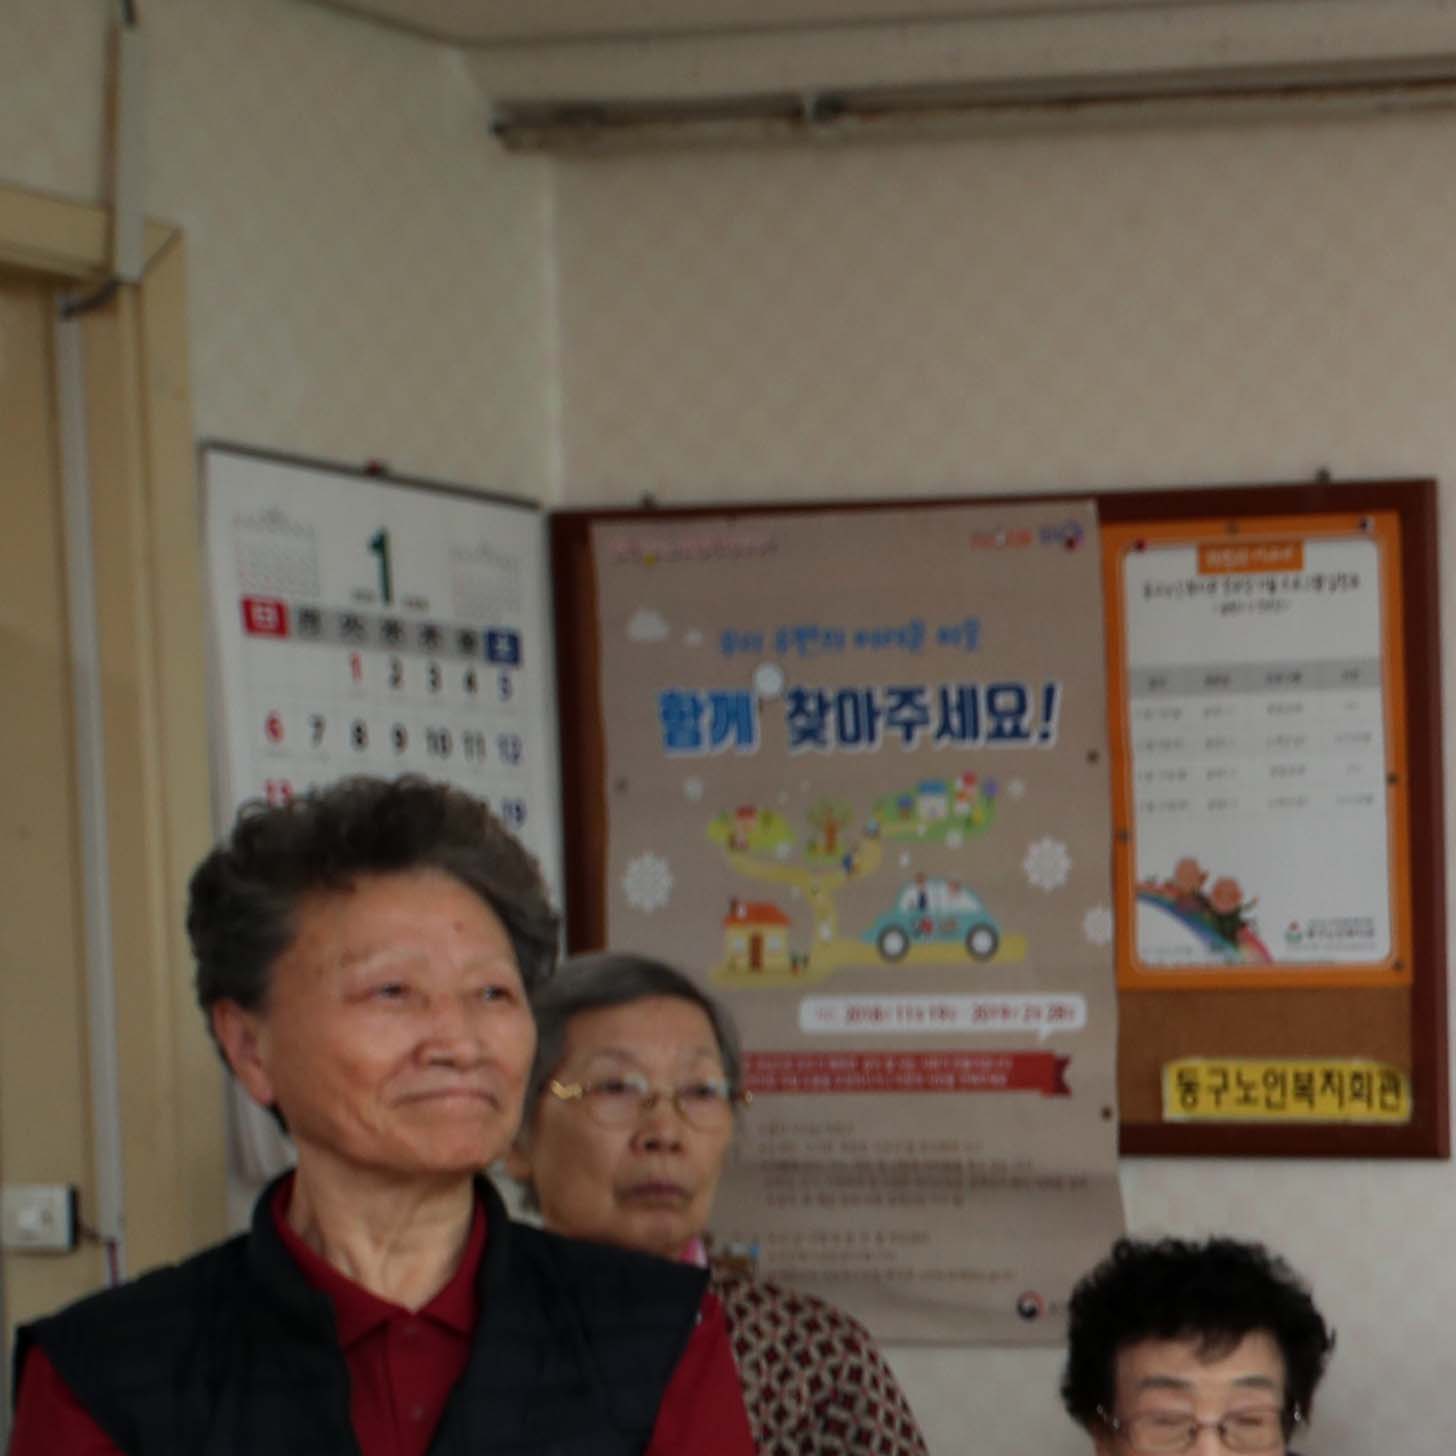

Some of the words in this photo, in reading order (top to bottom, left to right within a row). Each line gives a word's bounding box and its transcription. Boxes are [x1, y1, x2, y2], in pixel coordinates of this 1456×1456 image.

[367, 526, 394, 606] 1
[388, 656, 403, 689] 2
[426, 661, 441, 692] 3
[463, 665, 477, 694] 4
[265, 709, 285, 742] 6
[310, 714, 326, 743] 7
[350, 718, 369, 751] 8
[391, 724, 408, 754] 9
[427, 726, 452, 759] 10
[464, 731, 486, 762] 11
[497, 733, 523, 766] 12
[660, 690, 756, 748] 함께
[786, 683, 1056, 745] 찾아주세요!
[1176, 1066, 1400, 1112] 동구노인복지회관
